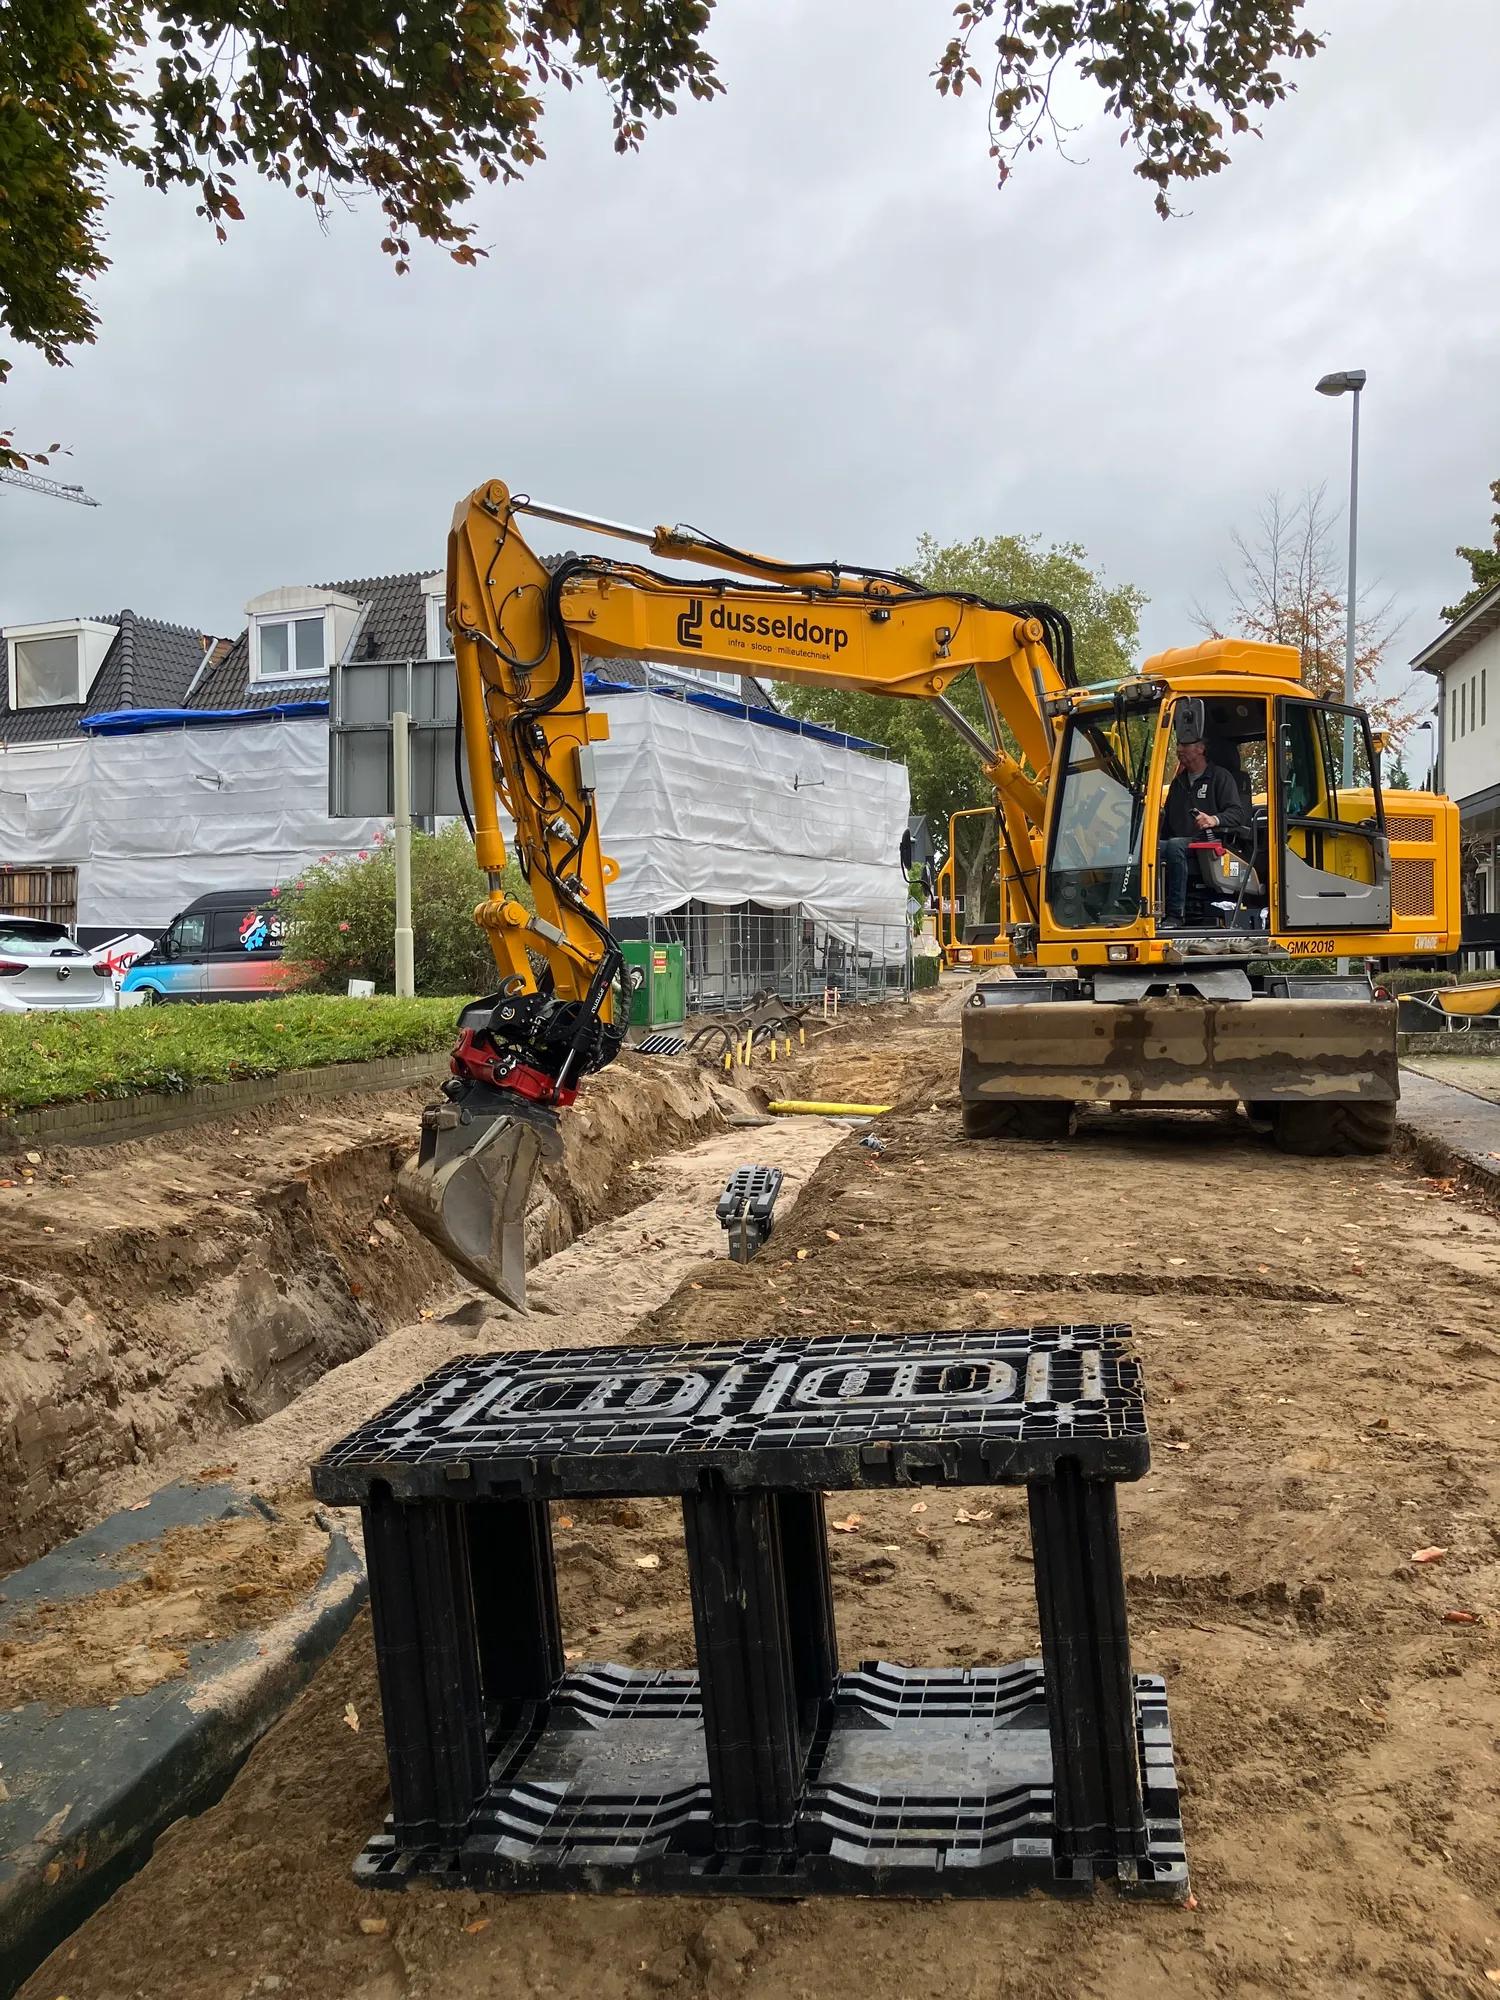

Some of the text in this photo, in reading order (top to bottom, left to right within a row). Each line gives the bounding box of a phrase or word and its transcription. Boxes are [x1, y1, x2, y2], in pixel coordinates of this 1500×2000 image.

[710, 604, 848, 652] dusseldorp
[728, 637, 746, 648] infra
[751, 642, 772, 653] sloop
[1121, 855, 1133, 893] VOLVO
[1287, 939, 1335, 955] GMK2018
